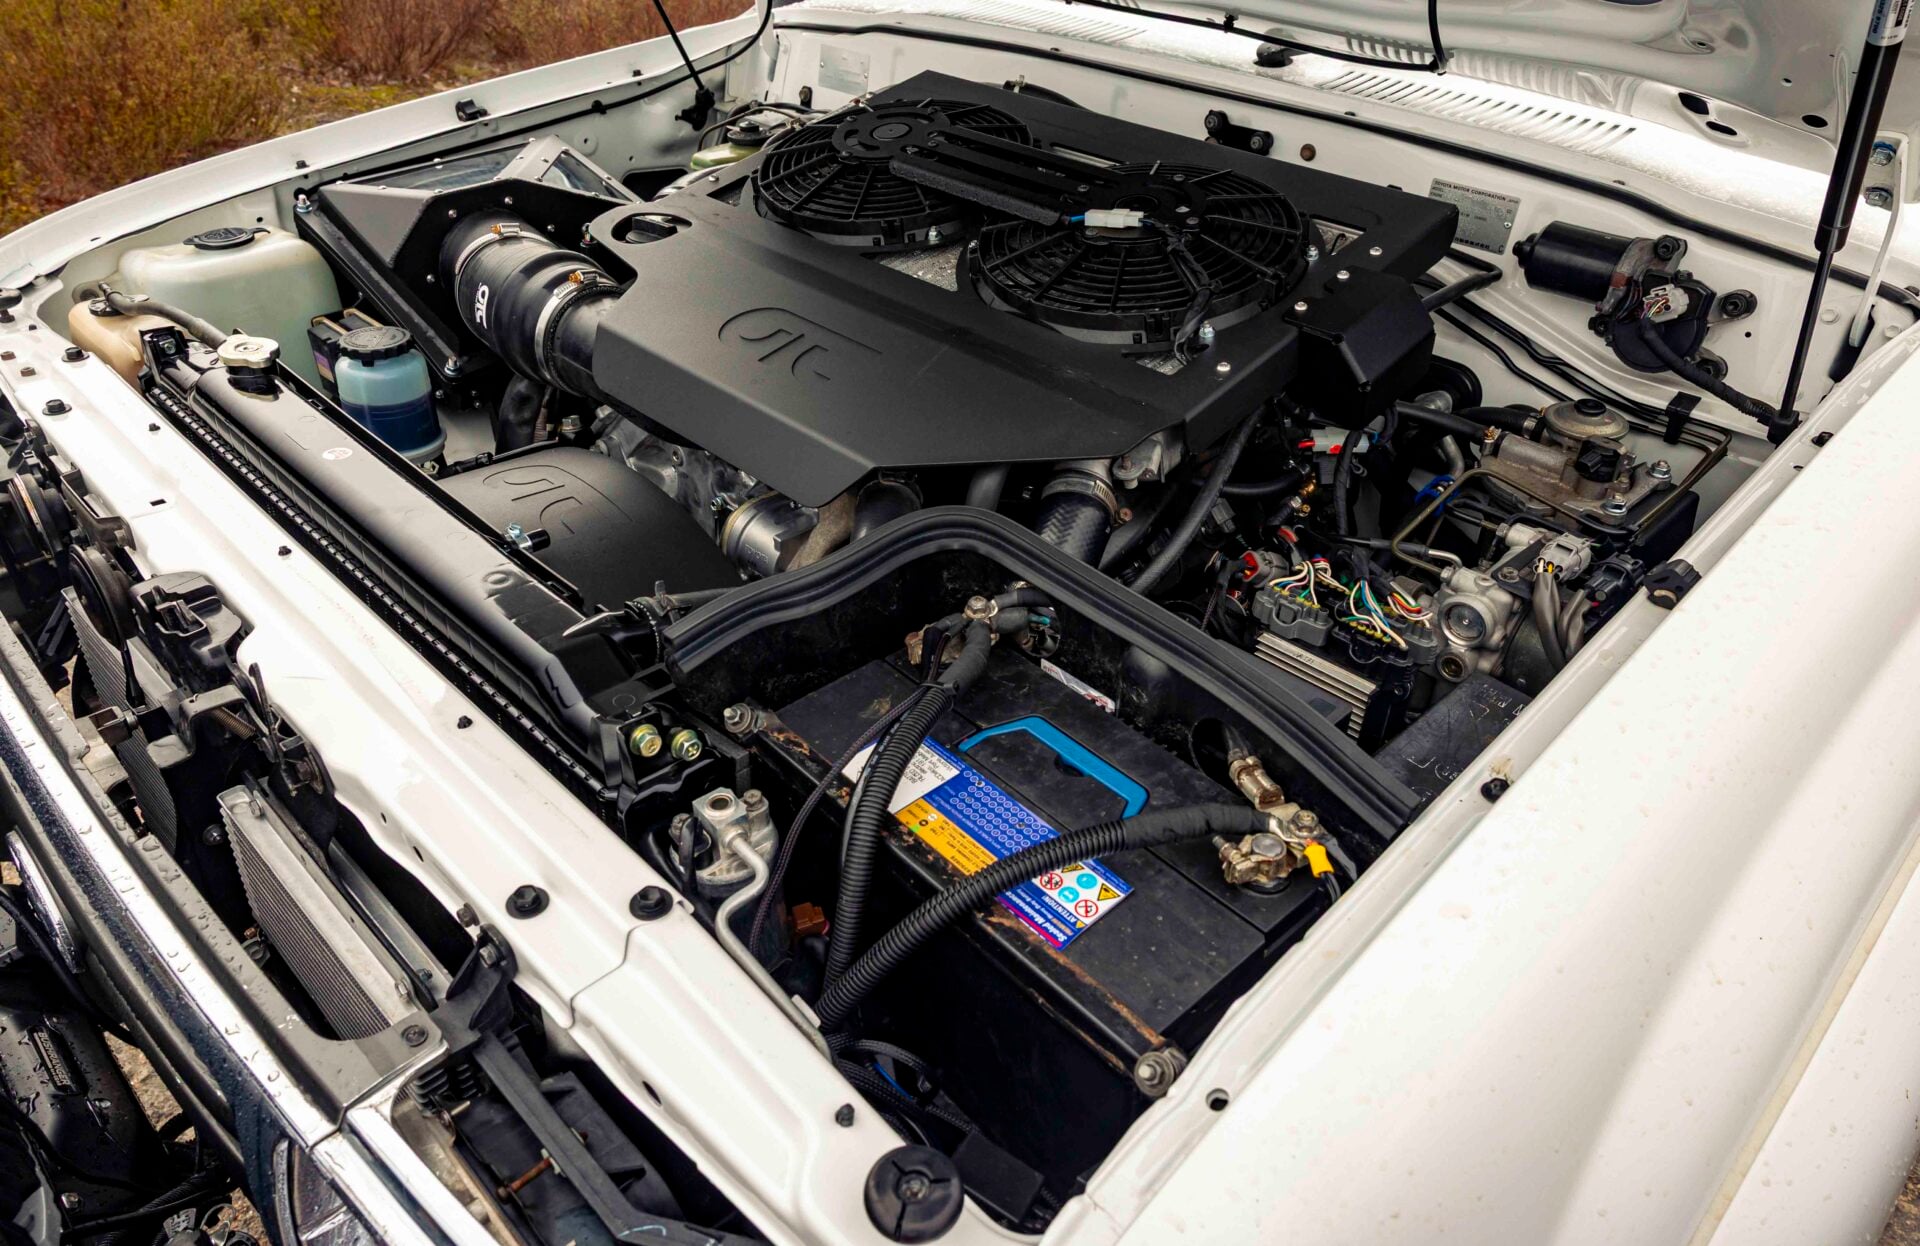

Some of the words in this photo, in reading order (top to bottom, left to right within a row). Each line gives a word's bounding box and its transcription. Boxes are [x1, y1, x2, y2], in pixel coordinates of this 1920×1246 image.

[1434, 181, 1452, 189] TOYOTA
[1453, 184, 1470, 193] MOTOR
[1471, 189, 1506, 201] CORPORATION
[1003, 890, 1045, 924] Maintenance
[1040, 893, 1077, 923] ATTENTION!
[1041, 921, 1067, 942] Sealed
[38, 1032, 71, 1085] BUSHRANGER
